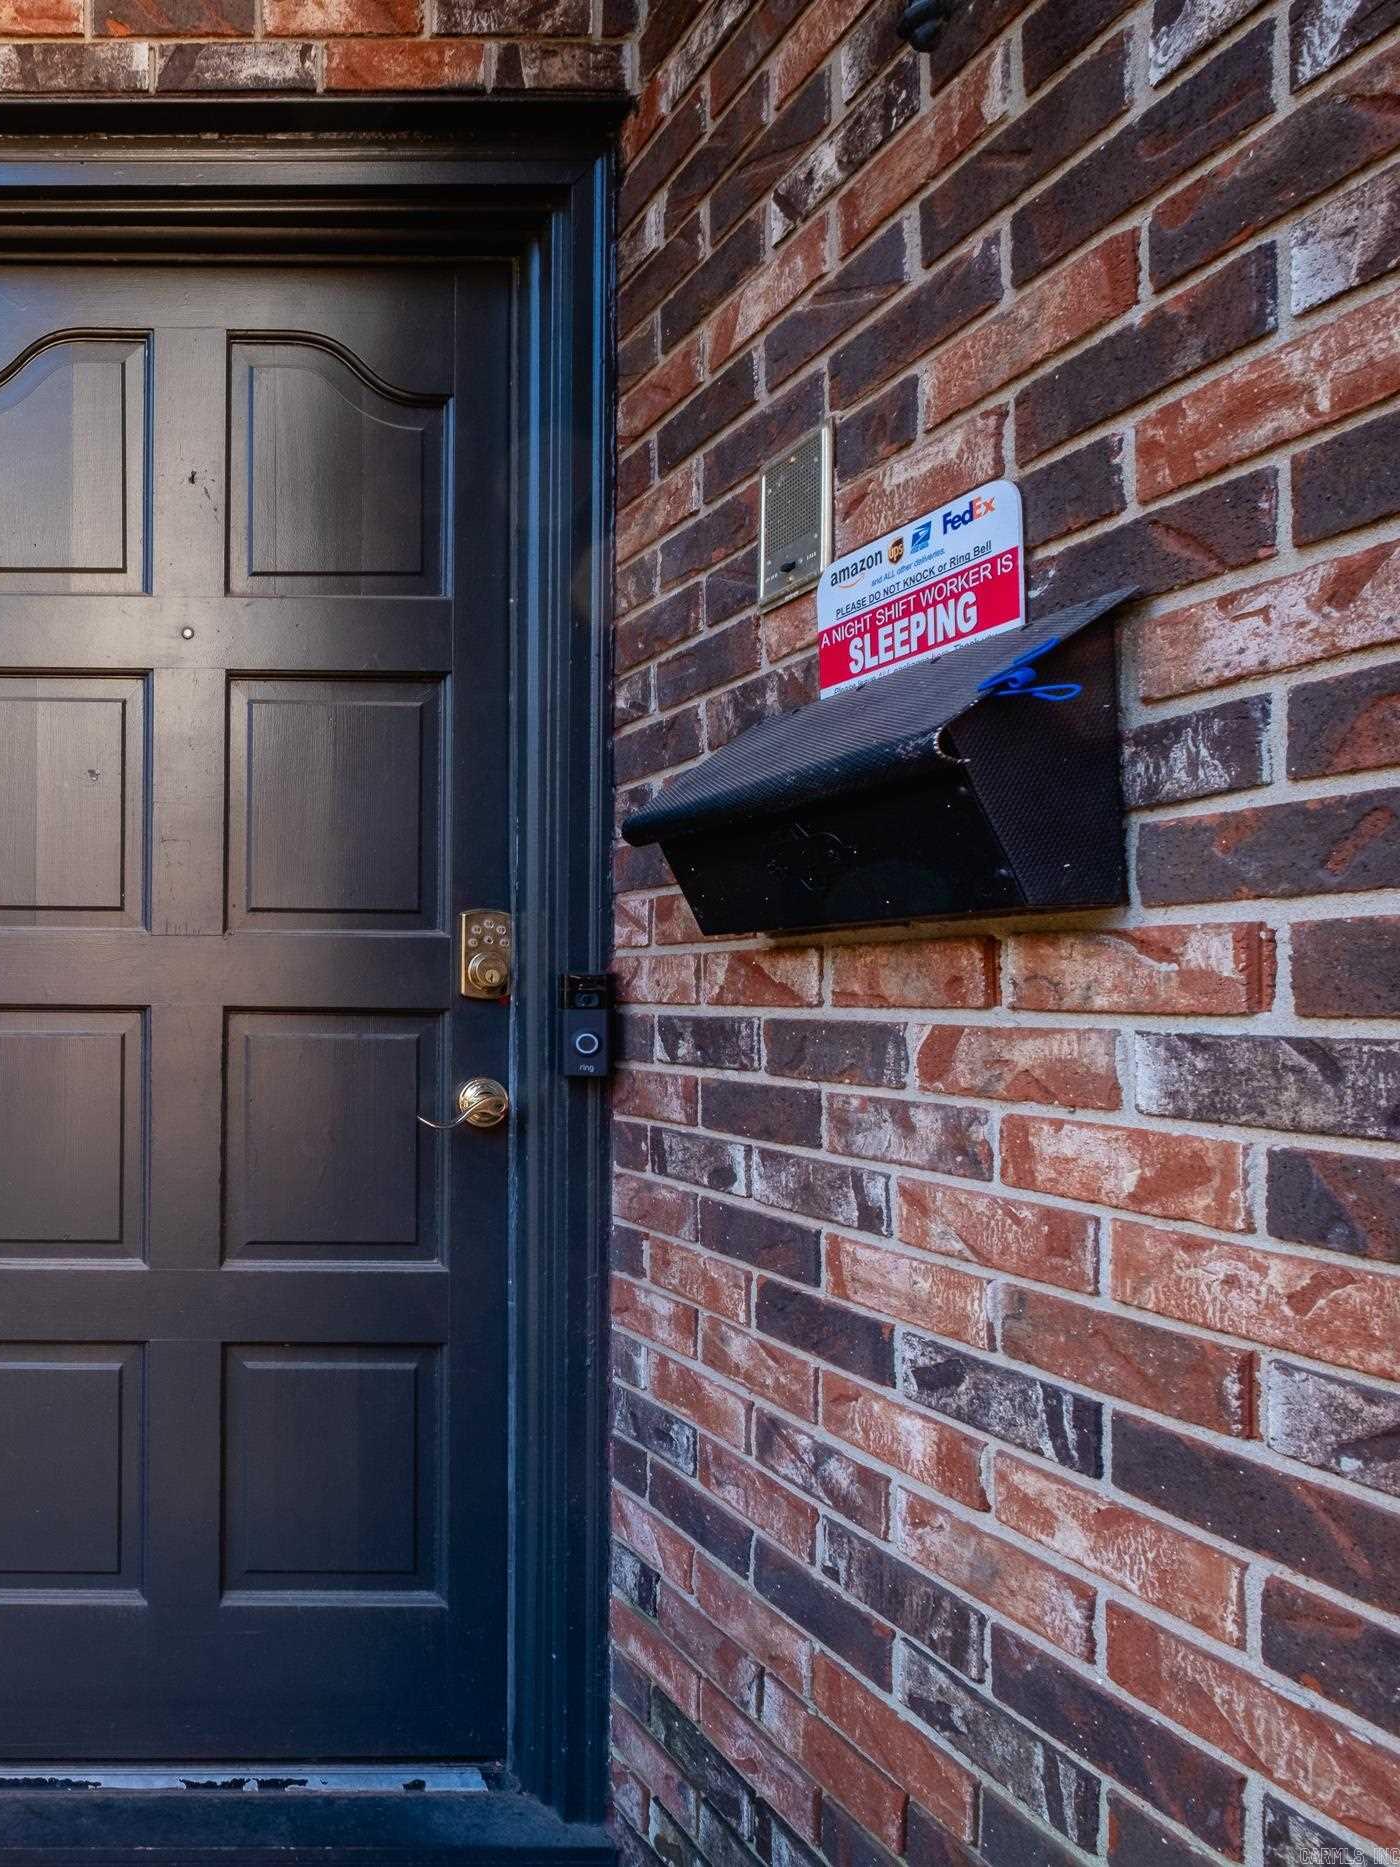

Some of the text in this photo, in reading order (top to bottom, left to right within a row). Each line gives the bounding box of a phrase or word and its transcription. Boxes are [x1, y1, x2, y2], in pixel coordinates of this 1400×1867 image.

[942, 496, 996, 535] FedEx
[830, 550, 882, 587] amazon
[888, 543, 904, 562] ups
[835, 540, 992, 618] PLEASE DO NOT KNOCK or Ring Bell
[883, 571, 895, 581] ALL
[821, 553, 1014, 649] A NIGHT SHIFT WORKER IS
[848, 591, 978, 675] SLEEPING
